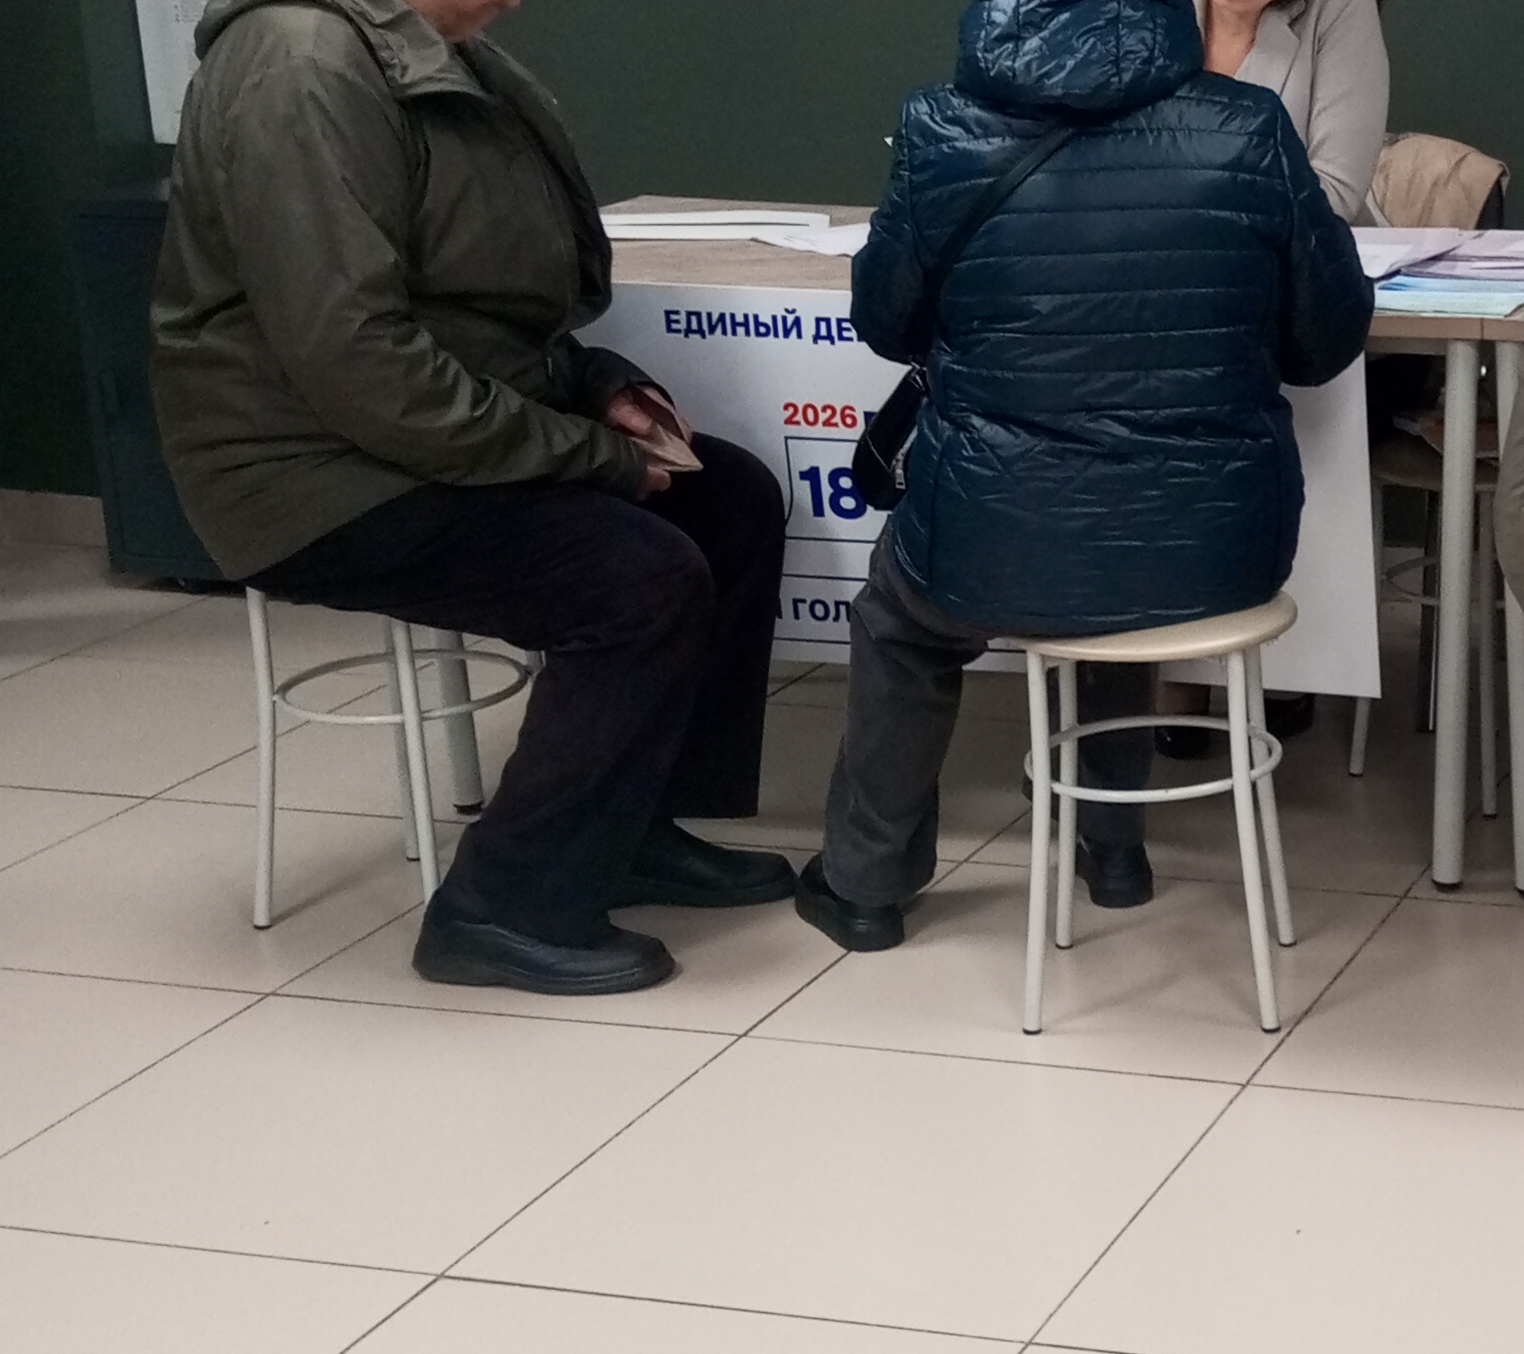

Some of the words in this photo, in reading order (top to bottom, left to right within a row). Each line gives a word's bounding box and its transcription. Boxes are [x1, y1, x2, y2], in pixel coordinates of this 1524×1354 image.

[664, 307, 803, 340] ЕДИНЫЙ
[812, 316, 866, 346] ДЕ
[783, 401, 859, 429] 2026
[798, 465, 868, 520] 18
[791, 597, 851, 623] ГОЛ
